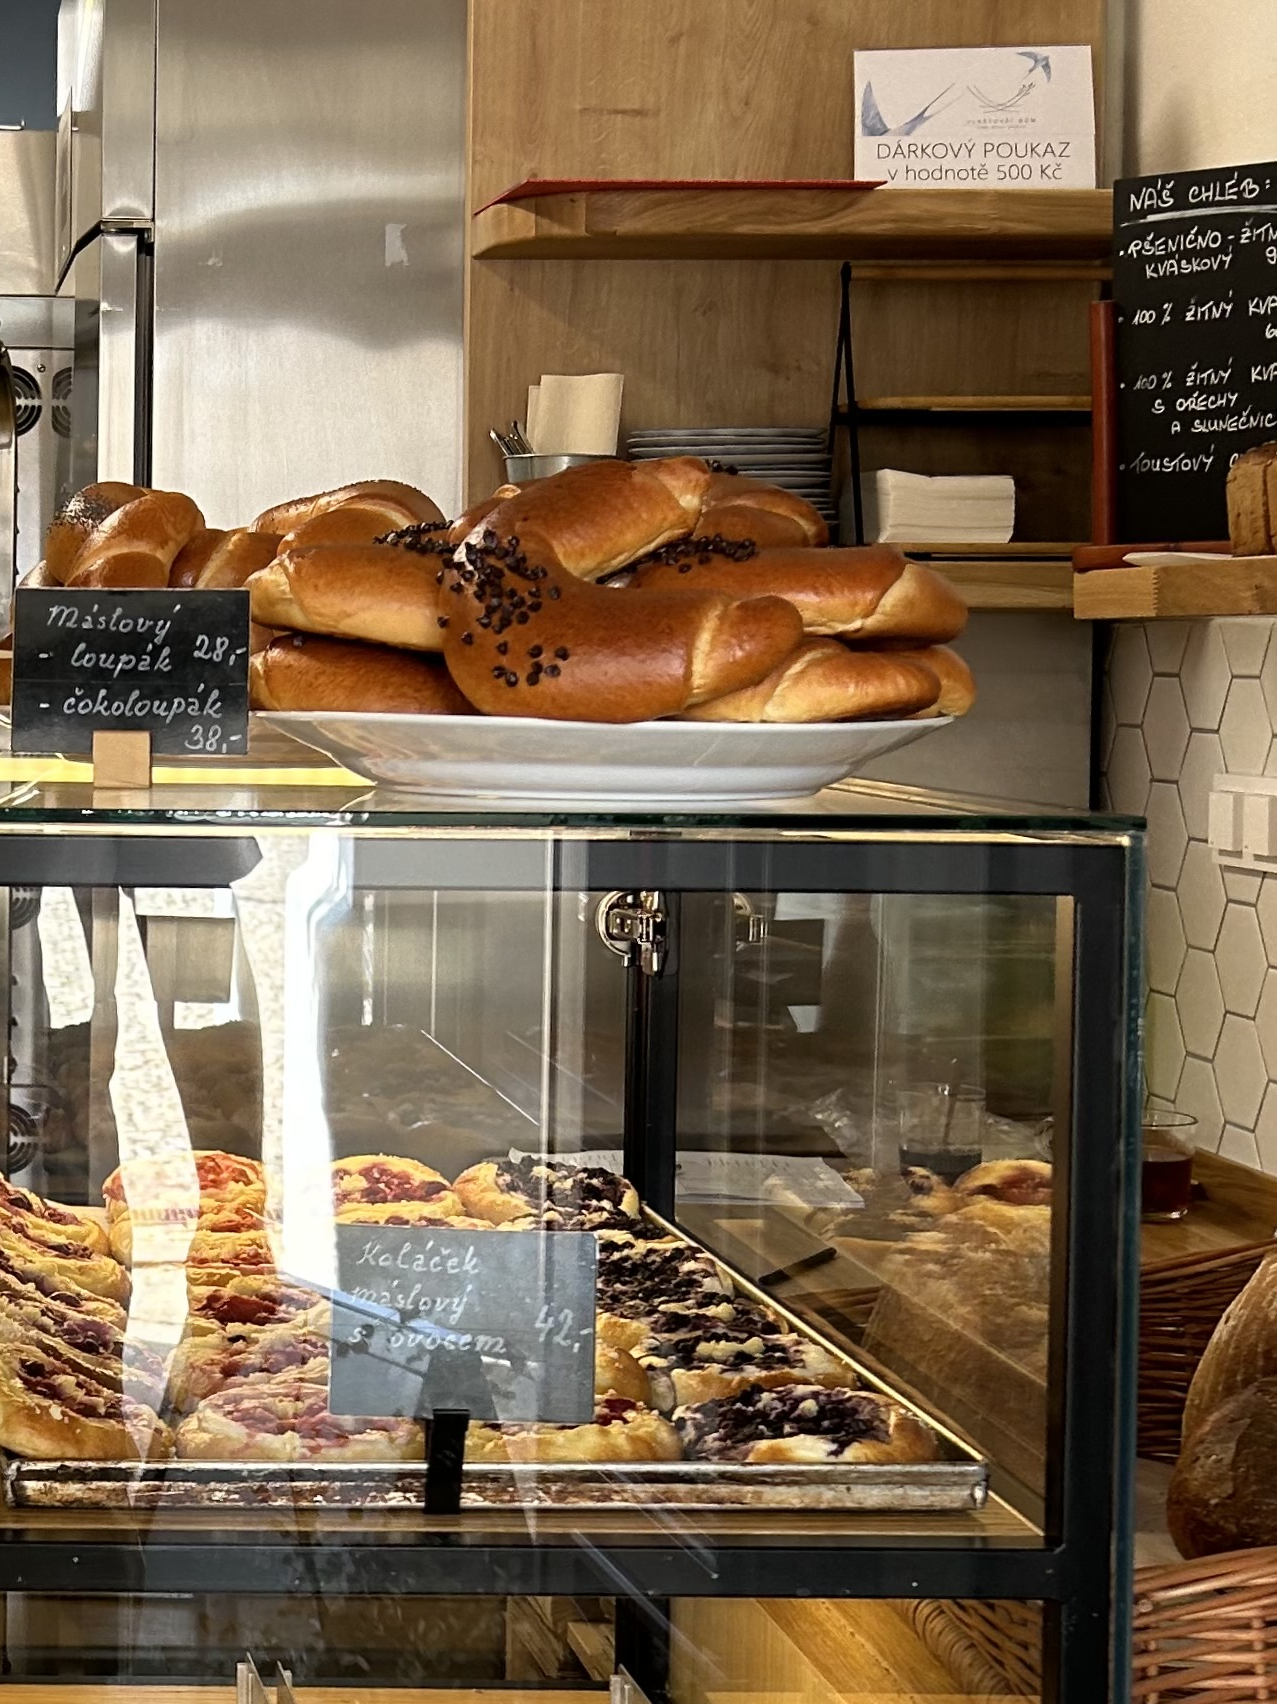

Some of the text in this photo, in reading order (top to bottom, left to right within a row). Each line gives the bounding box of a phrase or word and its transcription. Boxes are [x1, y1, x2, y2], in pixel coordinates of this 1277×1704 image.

[876, 138, 1071, 160] DÁRKOVÝ POUKAZ
[887, 162, 1064, 181] v hodnotě 500 Kč
[1129, 178, 1175, 212] NÁŠ
[1145, 245, 1233, 280] KVÁSKOVÝ
[1184, 289, 1233, 322] ŽITNÝ
[1185, 356, 1233, 387] ŽITNÝ
[1151, 390, 1239, 414] S OŘECHY
[1170, 420, 1182, 436] A
[1129, 443, 1215, 474] TOUSTOVÝ
[46, 603, 182, 645] Máslový
[70, 641, 173, 679] loupák
[62, 683, 224, 725] čokoloupák
[355, 1239, 482, 1276] Koláček
